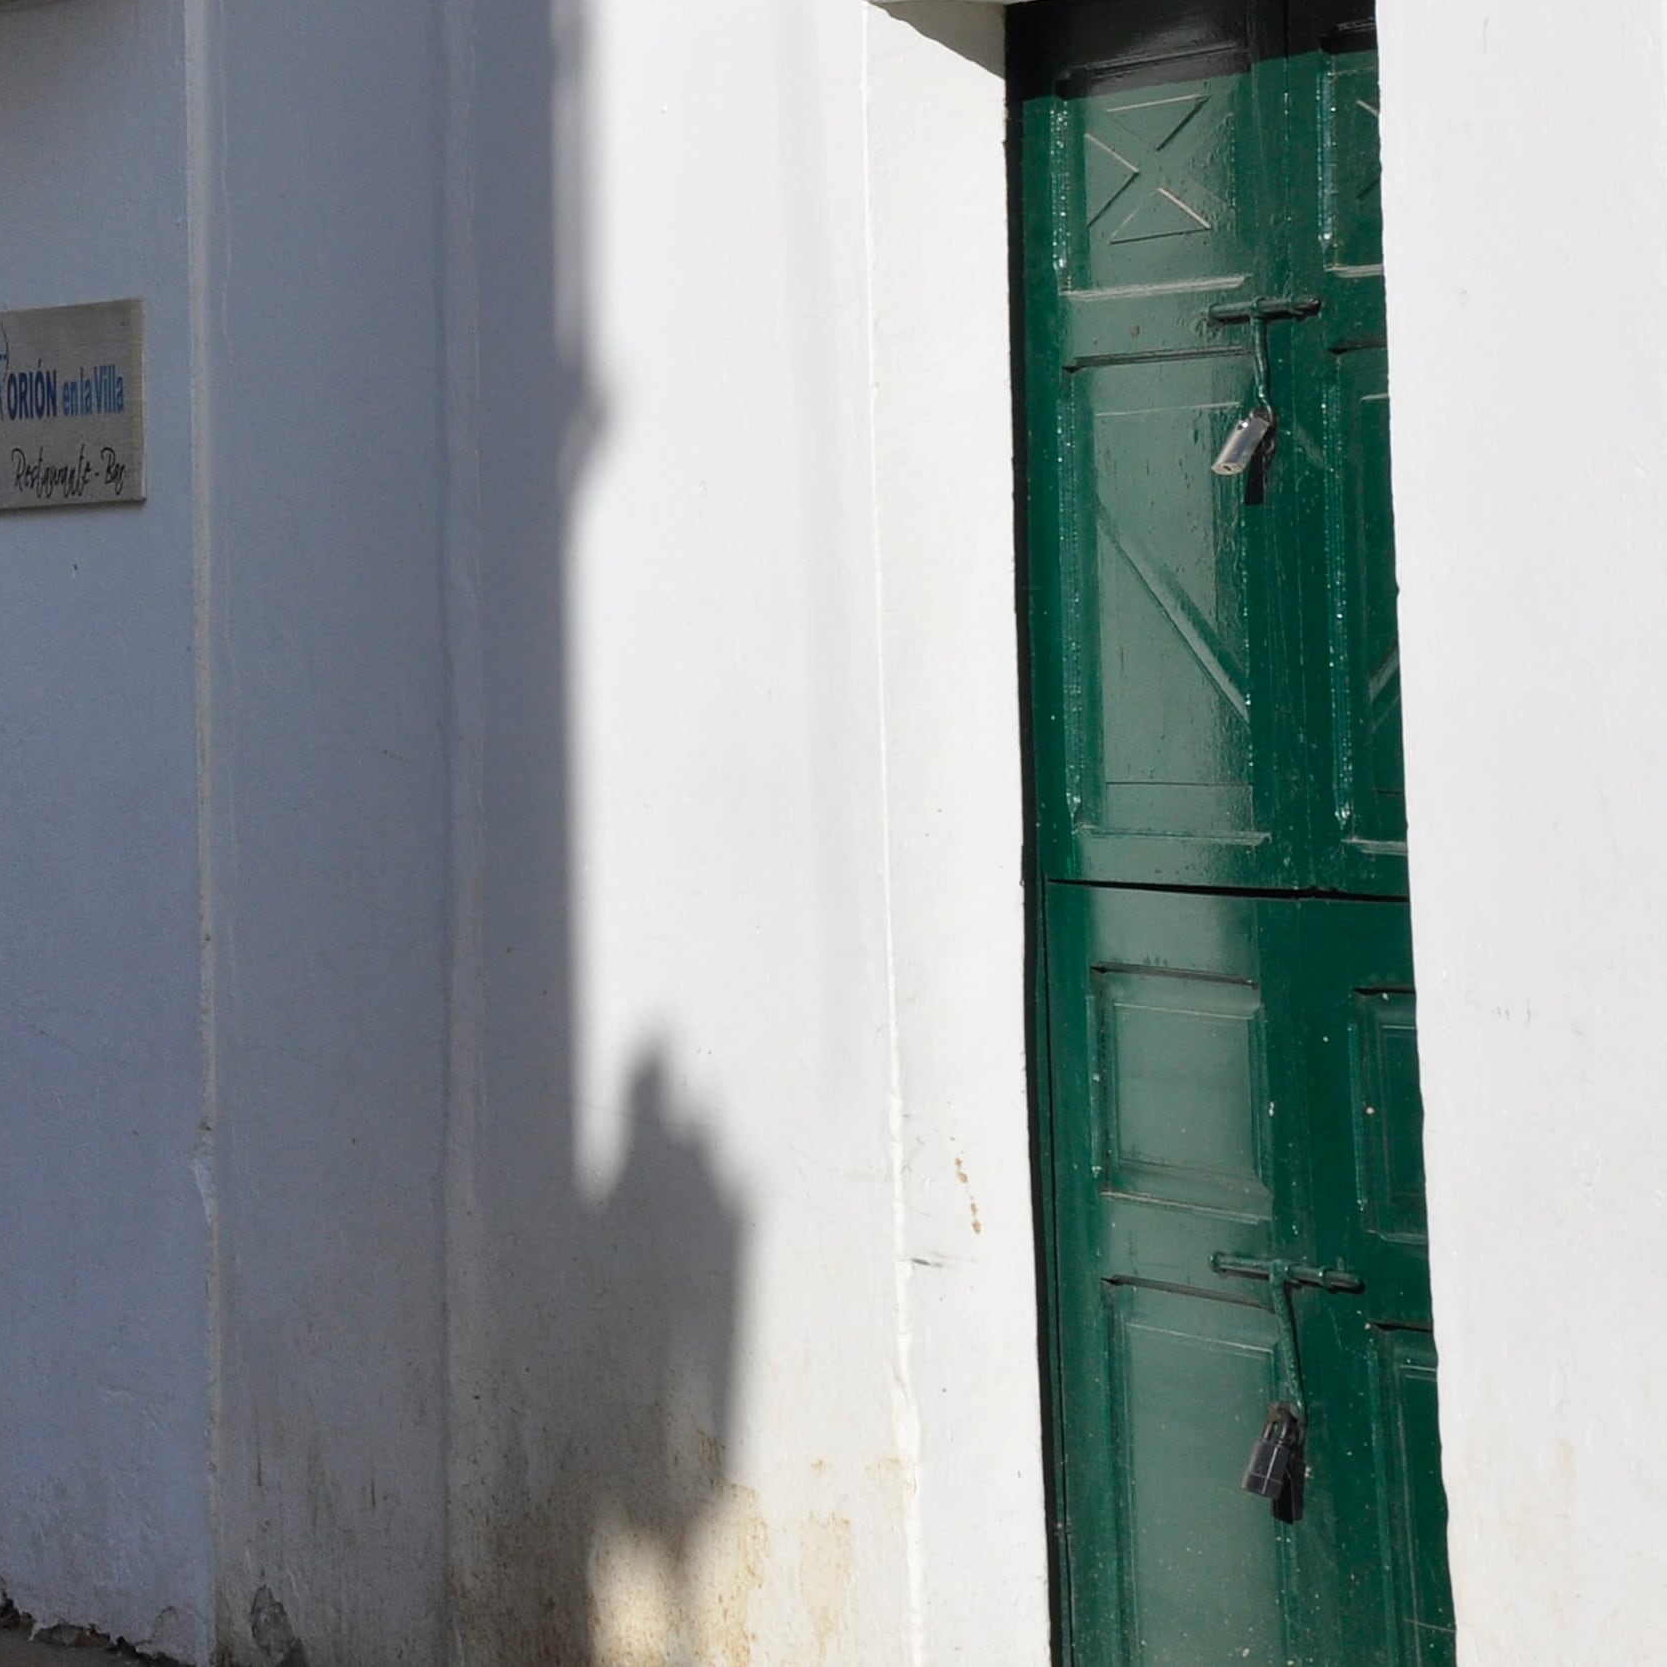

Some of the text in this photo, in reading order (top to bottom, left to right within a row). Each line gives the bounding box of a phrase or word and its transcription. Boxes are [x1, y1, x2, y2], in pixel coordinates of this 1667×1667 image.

[7, 359, 125, 421] ORIÓN en la Villa
